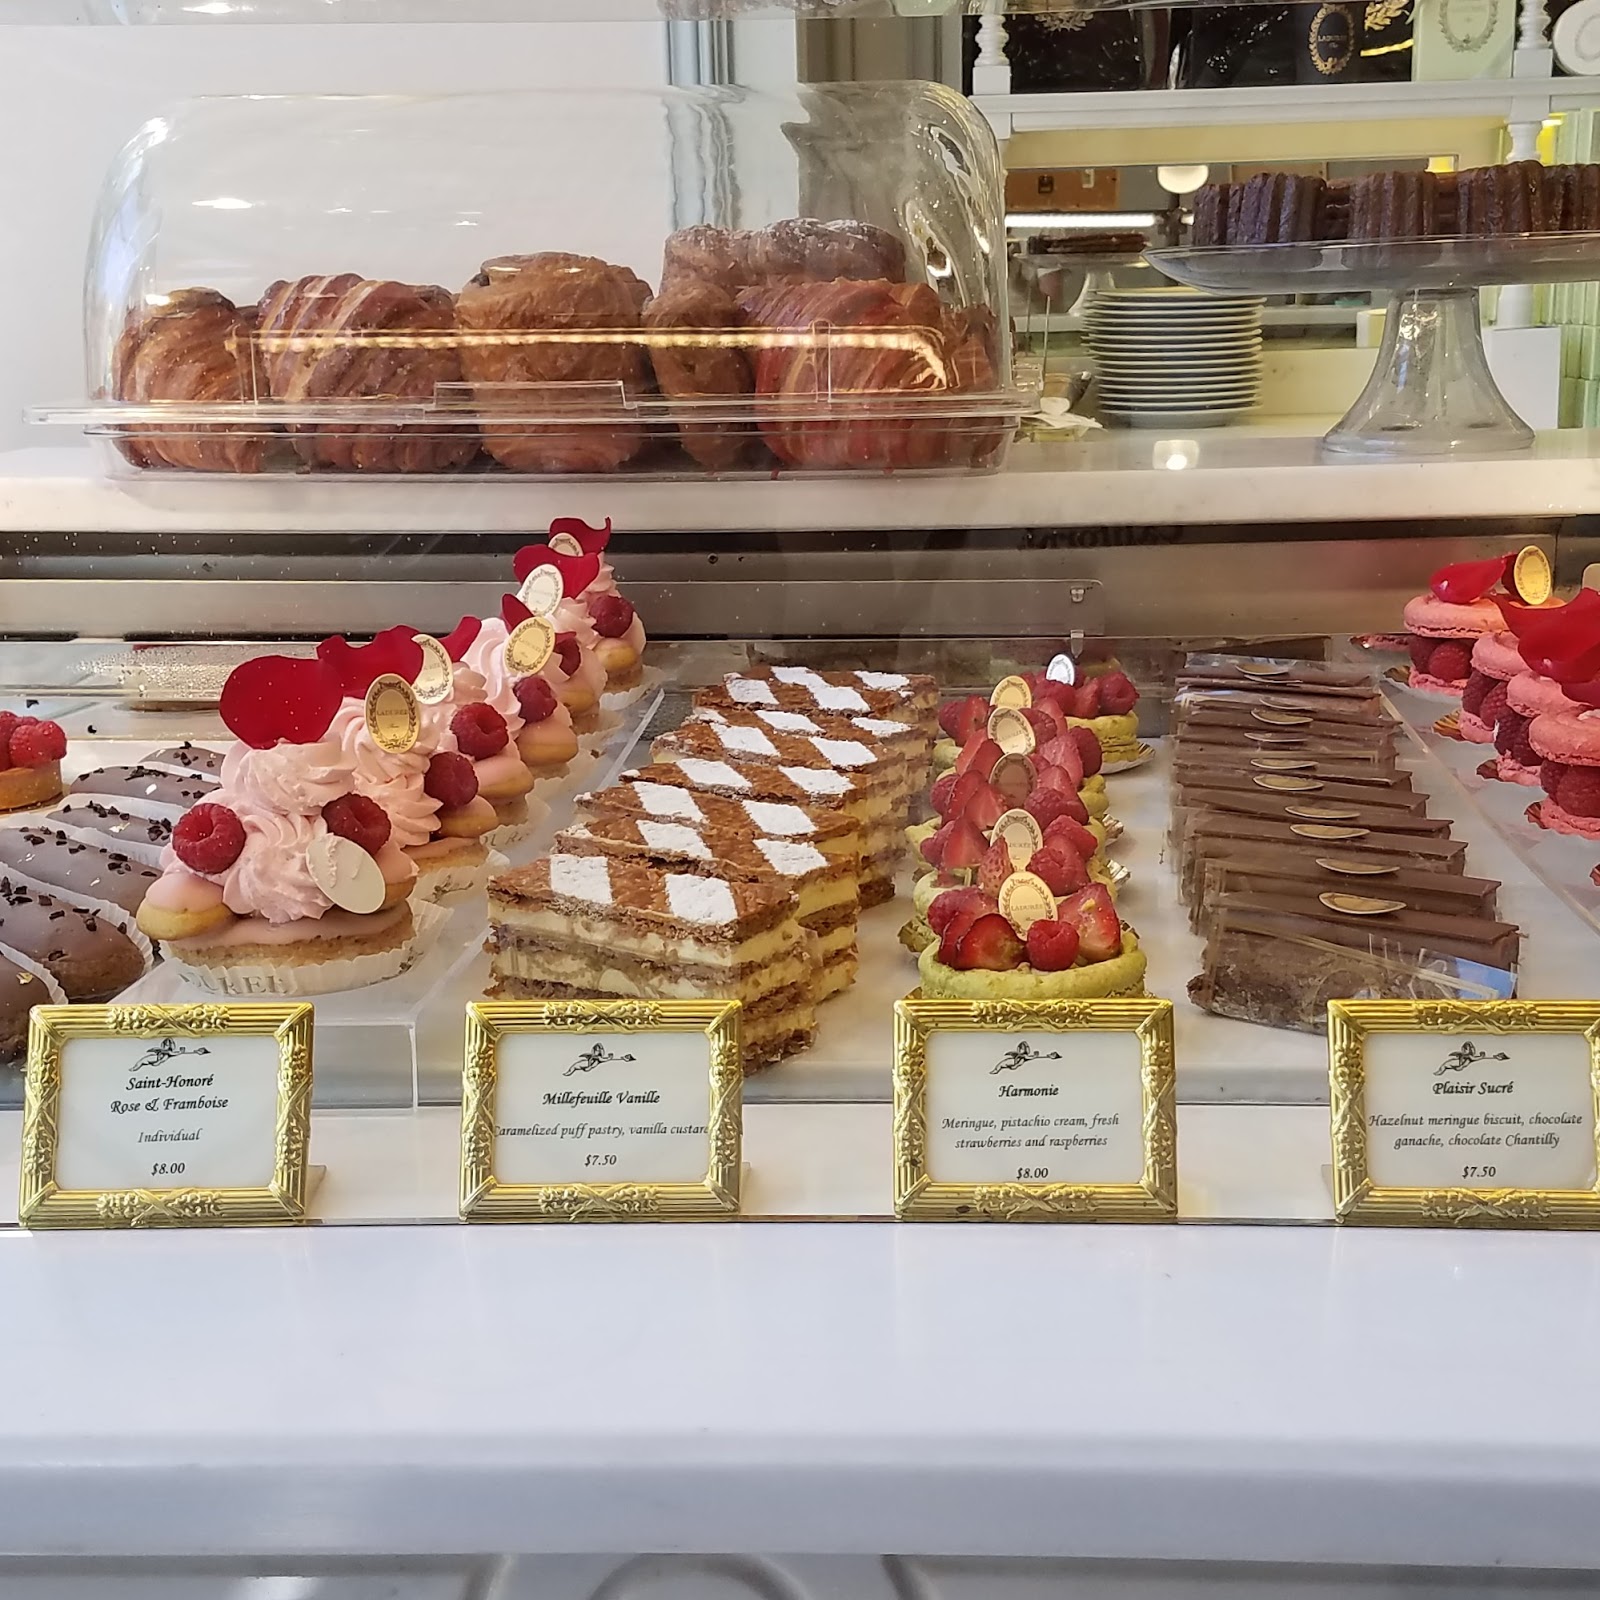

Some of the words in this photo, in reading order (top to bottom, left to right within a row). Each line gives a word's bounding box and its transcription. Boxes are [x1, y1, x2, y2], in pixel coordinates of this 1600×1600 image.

[126, 1074, 214, 1090] Saint-Honoré
[1433, 1081, 1476, 1094] Plaisir
[1478, 1081, 1514, 1095] Sucré
[998, 1084, 1059, 1097] Harmonie
[111, 1101, 141, 1114] Rose
[145, 1097, 160, 1111] &
[163, 1095, 228, 1110] Framboise
[542, 1091, 612, 1108] Millefeuille
[616, 1091, 660, 1104] Vanille
[942, 1117, 996, 1131] Meringue,
[1000, 1115, 1050, 1131] pistachio
[1054, 1118, 1087, 1127] cream,
[1089, 1113, 1119, 1129] fresh
[1369, 1114, 1424, 1126] Hazelnut
[1428, 1114, 1479, 1129] meringue
[1484, 1113, 1524, 1126] biscuit,
[1529, 1112, 1582, 1124] chocolate
[138, 1128, 203, 1143] Individual
[560, 1123, 588, 1139] puff
[587, 1123, 624, 1139] pastry,
[629, 1122, 667, 1134] vanilla
[955, 1136, 1022, 1148] strawberries
[1025, 1135, 1048, 1146] and
[1050, 1134, 1107, 1150] raspberries
[1394, 1134, 1444, 1150] ganache,
[1448, 1133, 1501, 1145] chocolate
[1505, 1133, 1559, 1148] Chantilly
[585, 1154, 617, 1167] $7.50
[151, 1163, 185, 1176] $8.00
[1016, 1168, 1048, 1180] $8.00
[1462, 1166, 1496, 1179] $7.50
